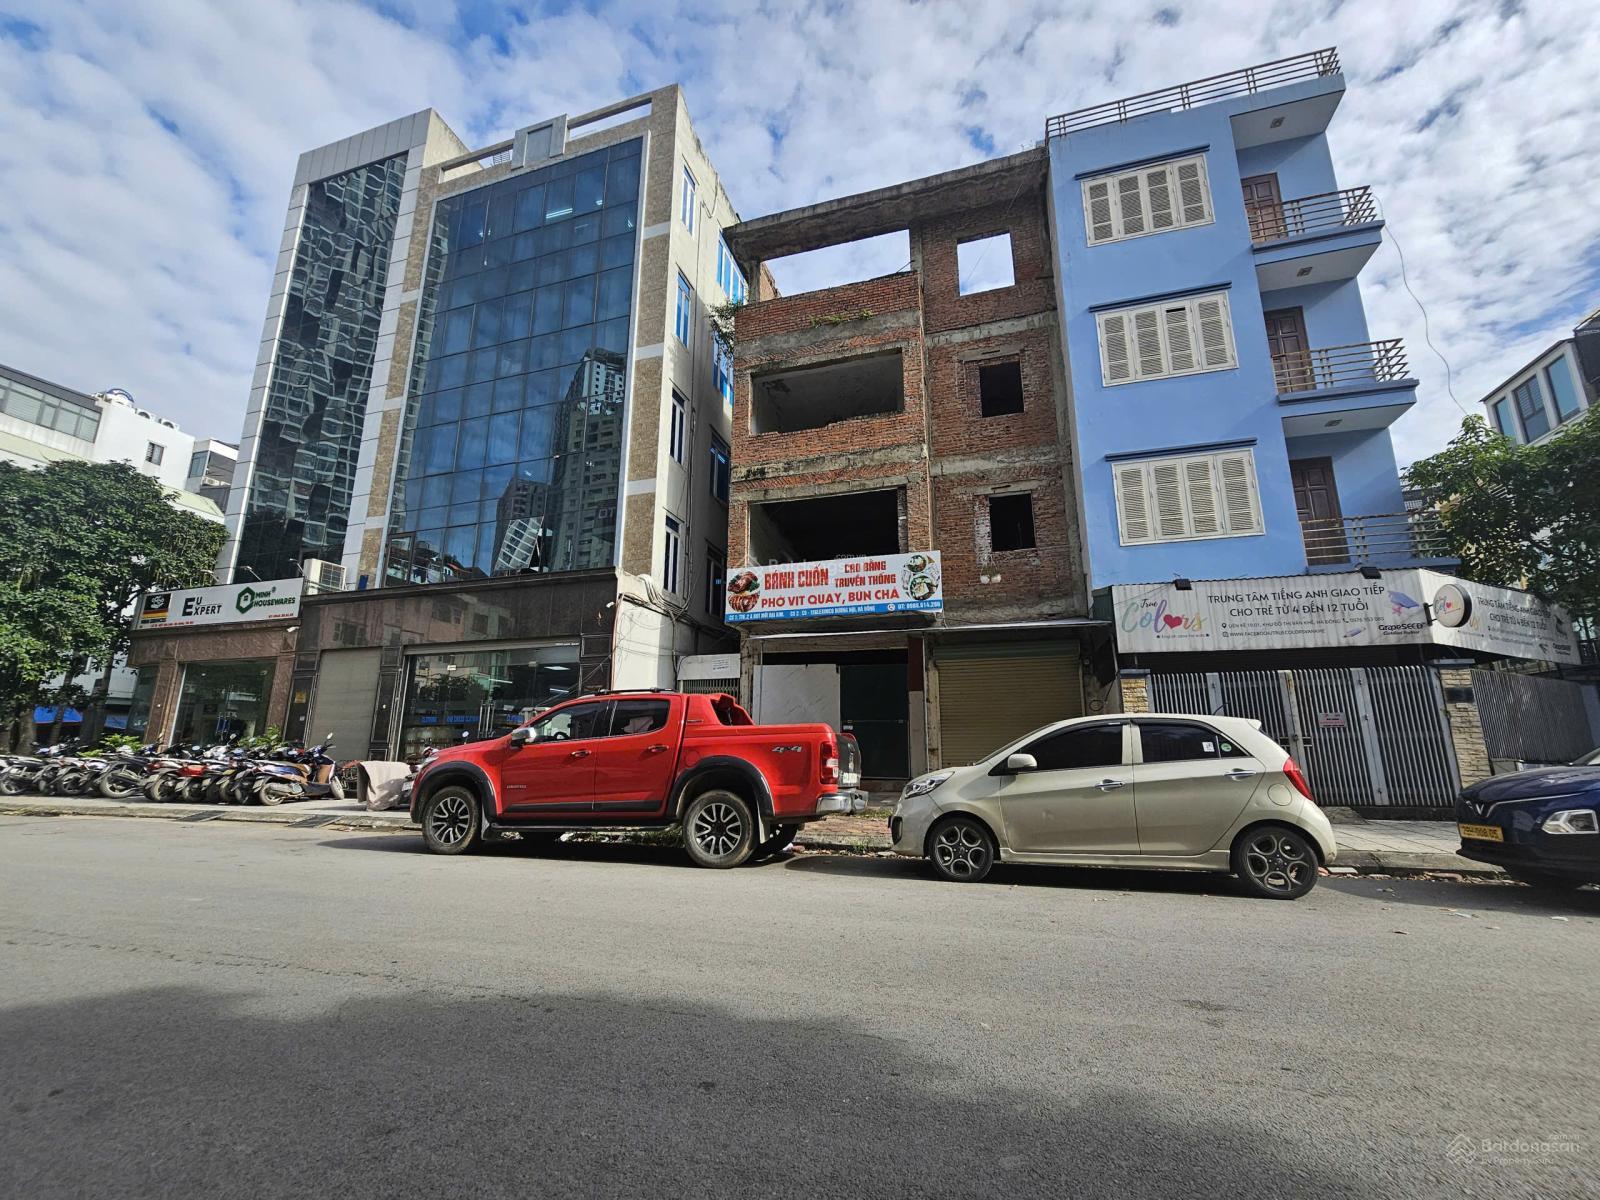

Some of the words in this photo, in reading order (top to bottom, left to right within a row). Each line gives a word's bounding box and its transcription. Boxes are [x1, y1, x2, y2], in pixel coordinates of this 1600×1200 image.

[765, 570, 794, 590] BÁNH
[798, 562, 829, 587] CUỐN
[253, 597, 296, 607] HOUSEWARES
[1207, 594, 1243, 604] TRUNG
[1245, 591, 1269, 602] TÂM
[1271, 587, 1302, 601] TIẾNG
[1305, 589, 1328, 599] ANH
[1330, 588, 1360, 597] GIAO
[1362, 582, 1384, 595] TIẾP
[1230, 608, 1252, 617] CHO
[1292, 606, 1299, 614] 4
[1302, 600, 1324, 613] ĐẾN
[1327, 603, 1339, 612] 12
[1340, 598, 1369, 611] TUỔI
